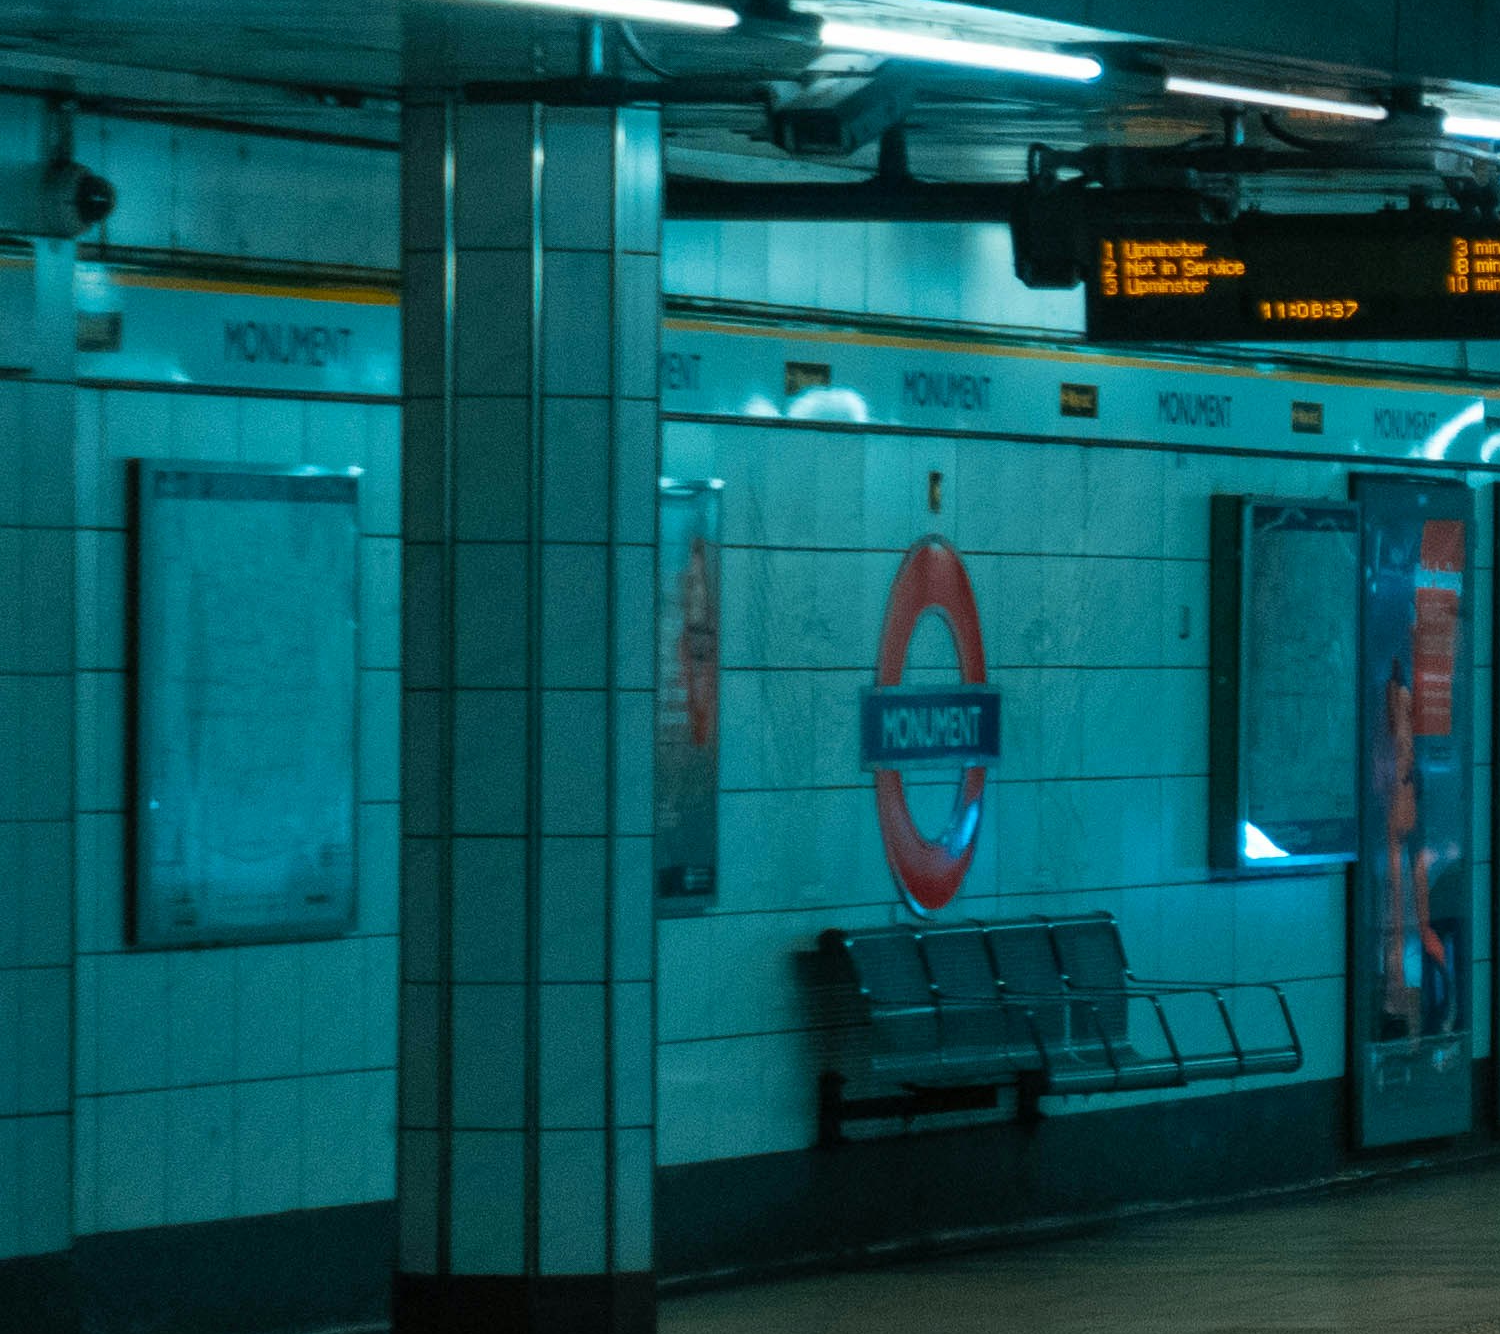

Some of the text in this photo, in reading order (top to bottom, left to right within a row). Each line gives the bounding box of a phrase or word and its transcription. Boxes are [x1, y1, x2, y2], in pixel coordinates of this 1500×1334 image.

[1121, 239, 1209, 260] Upminster
[1160, 258, 1177, 276] in
[1181, 257, 1247, 277] Service
[1123, 276, 1210, 297] Upminster
[1260, 299, 1359, 319] 11:08:37
[881, 705, 982, 748] MONUMENT
